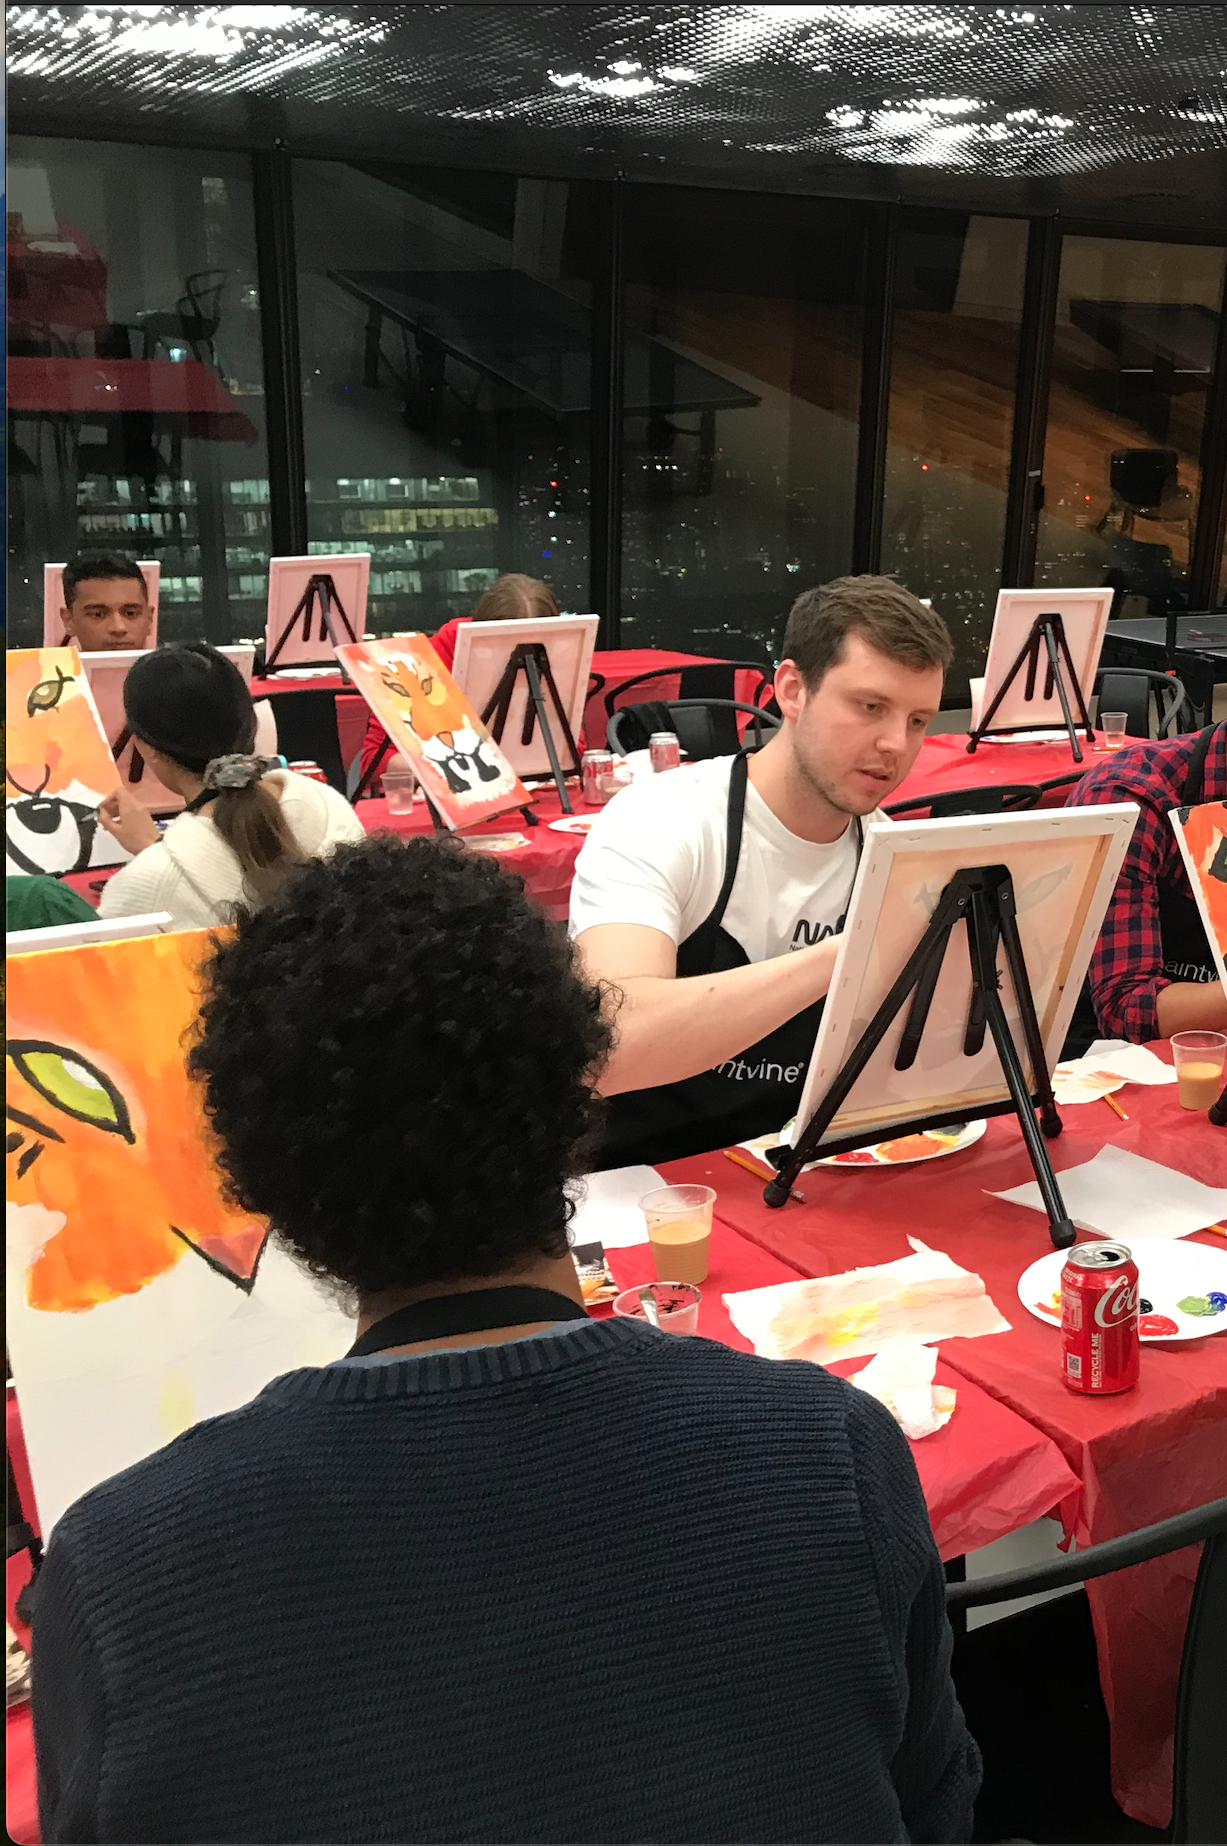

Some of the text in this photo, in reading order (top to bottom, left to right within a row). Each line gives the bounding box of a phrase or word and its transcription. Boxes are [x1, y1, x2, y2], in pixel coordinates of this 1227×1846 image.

[1164, 960, 1219, 983] aintv
[717, 1058, 800, 1083] ntvine
[1091, 1332, 1099, 1388] RECYCLE ME
